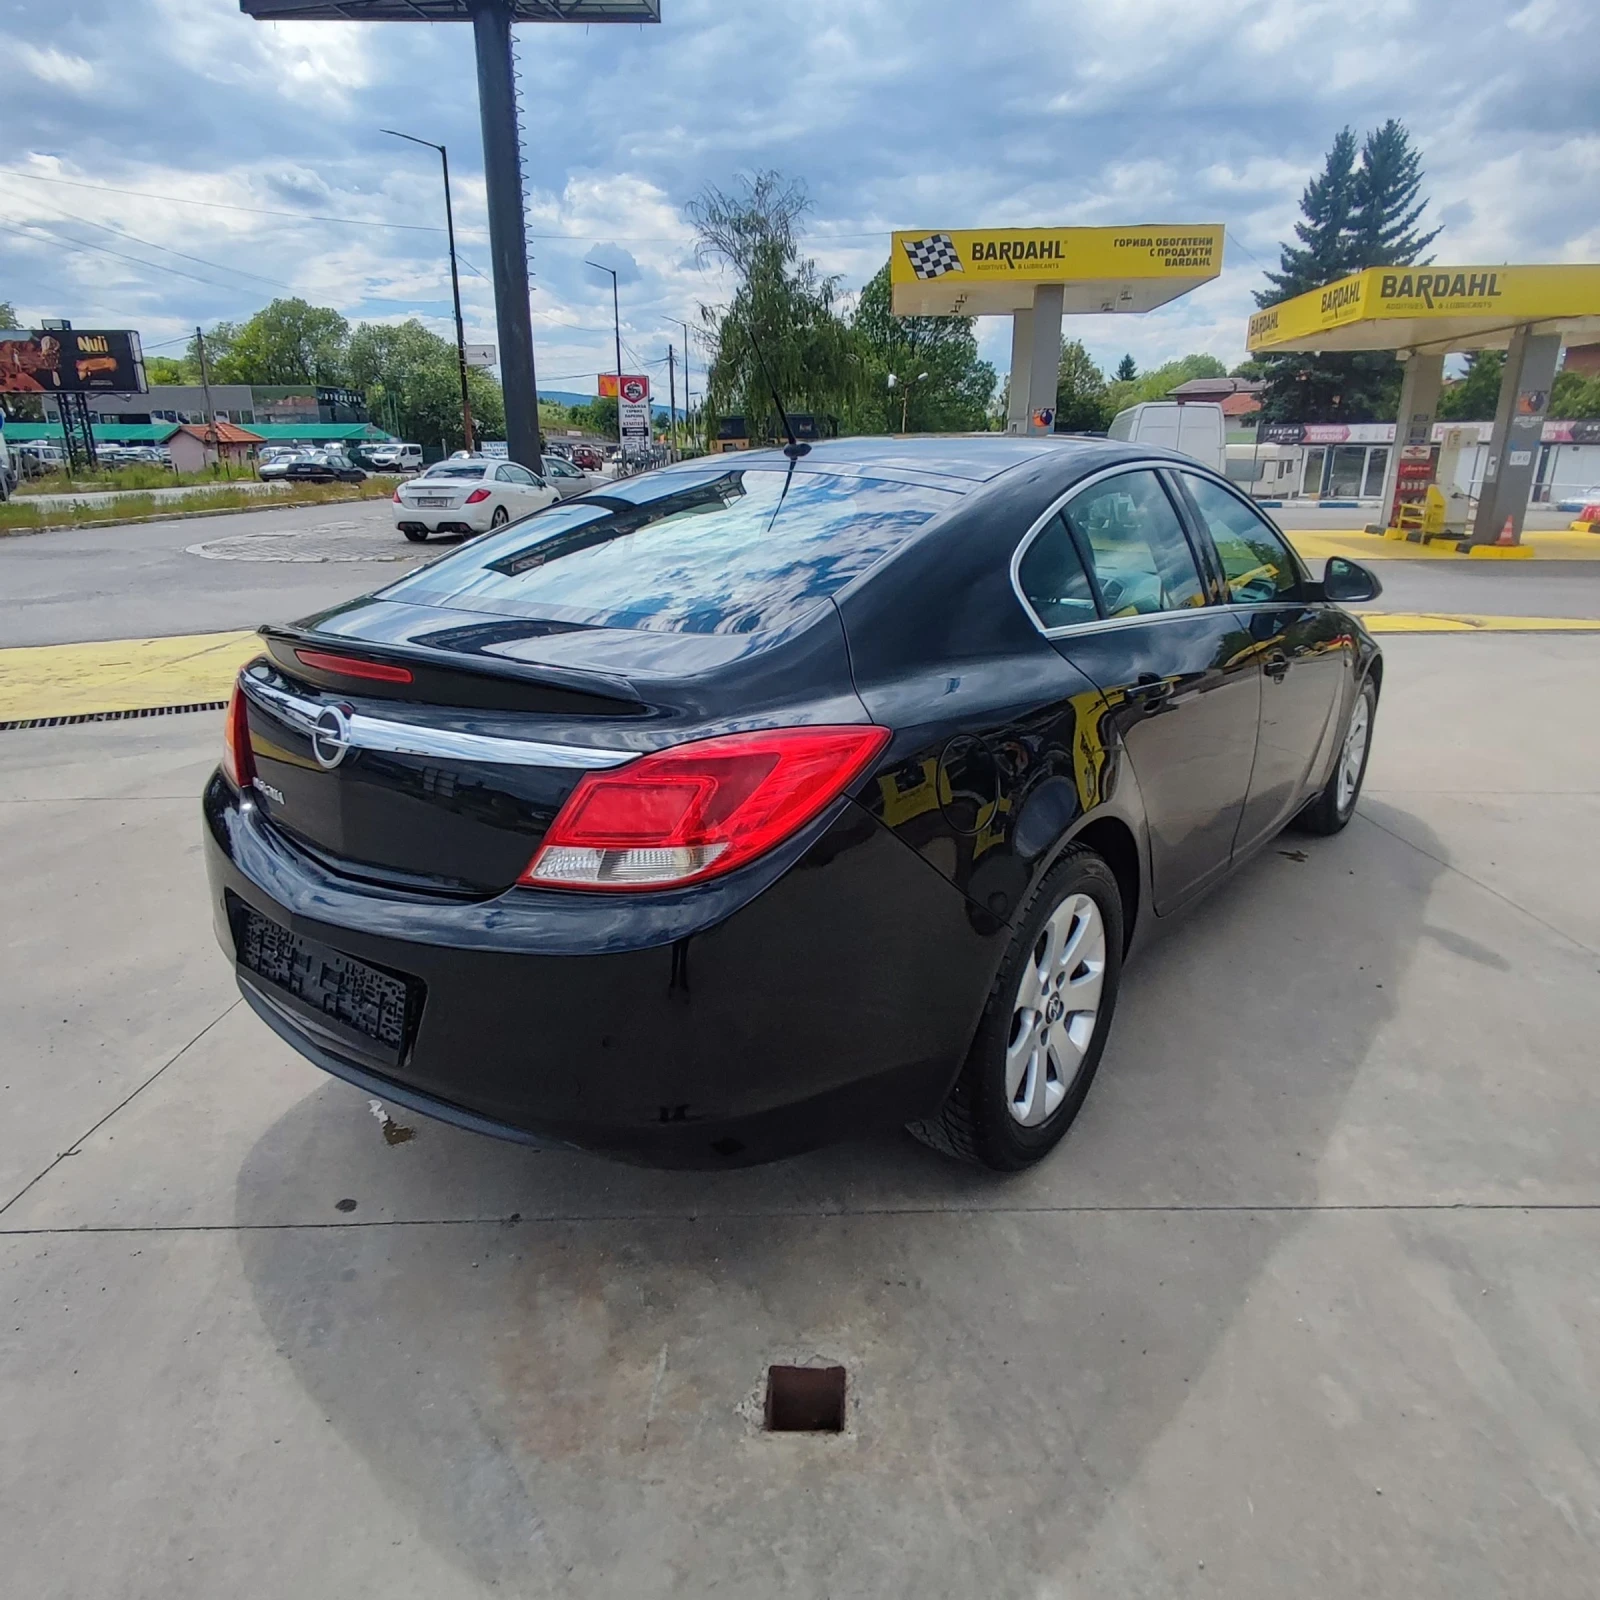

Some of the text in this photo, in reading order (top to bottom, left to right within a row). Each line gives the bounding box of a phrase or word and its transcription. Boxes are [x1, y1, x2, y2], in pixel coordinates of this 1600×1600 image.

[1114, 237, 1213, 247] ГОРИВА ОБОГАТЕНИ
[972, 241, 1065, 269] BARDAHL
[1158, 248, 1212, 257] ПРОДУКТИ
[1024, 262, 1059, 270] LUBRICANTS
[1165, 258, 1211, 267] BARDAHL
[1381, 273, 1502, 309] BARDAHL
[1321, 281, 1361, 319] BARDAHL
[1446, 301, 1492, 309] LUBRICANTS
[1250, 311, 1279, 341] BARDAHL
